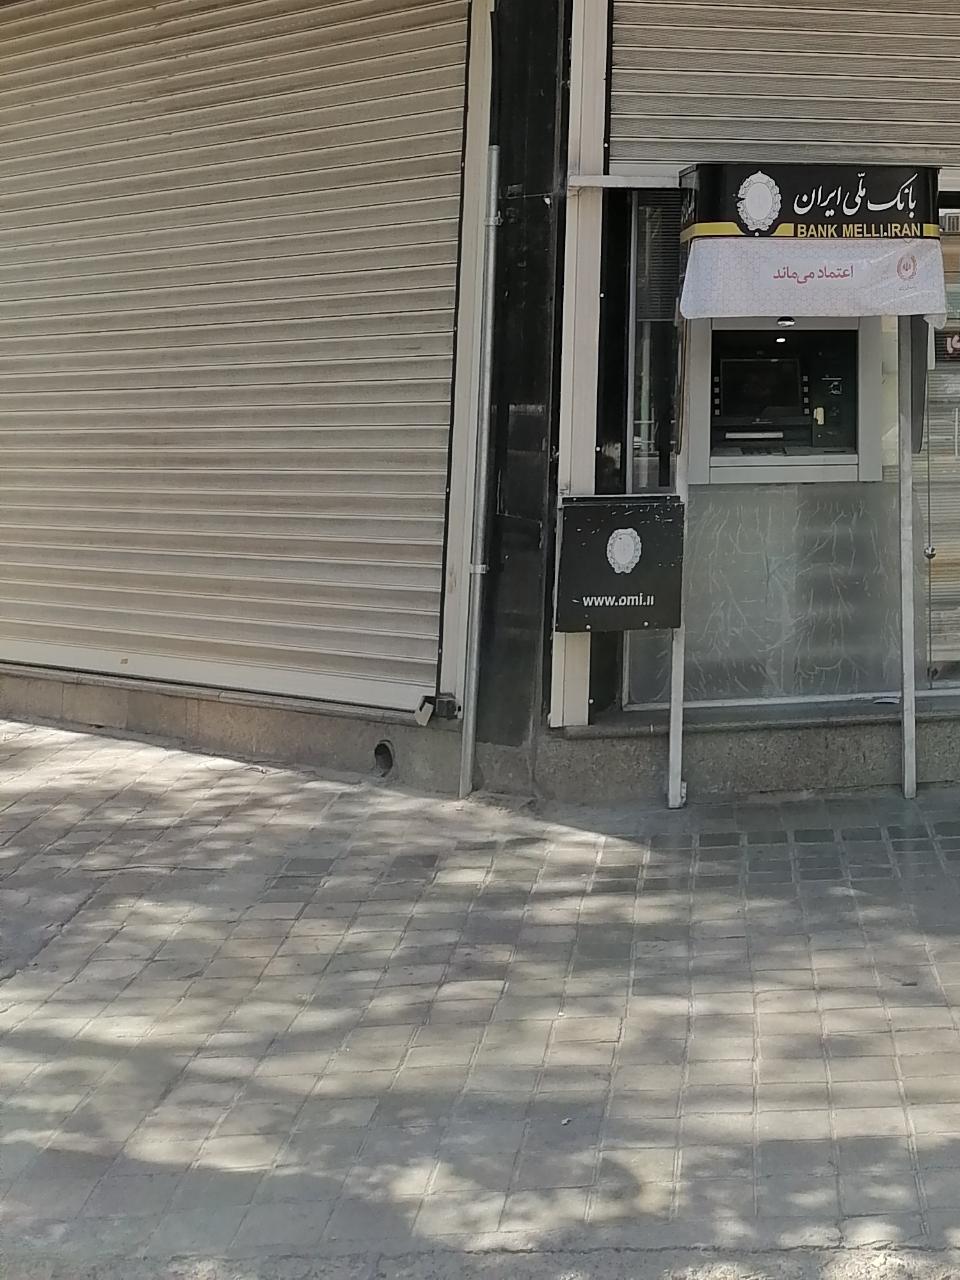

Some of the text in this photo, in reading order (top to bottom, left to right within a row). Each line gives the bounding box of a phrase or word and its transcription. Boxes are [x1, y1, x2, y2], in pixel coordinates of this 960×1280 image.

[793, 184, 842, 217] ایران
[866, 172, 919, 219] بانک
[797, 223, 838, 238] BANK
[817, 264, 854, 280] اعتماد
